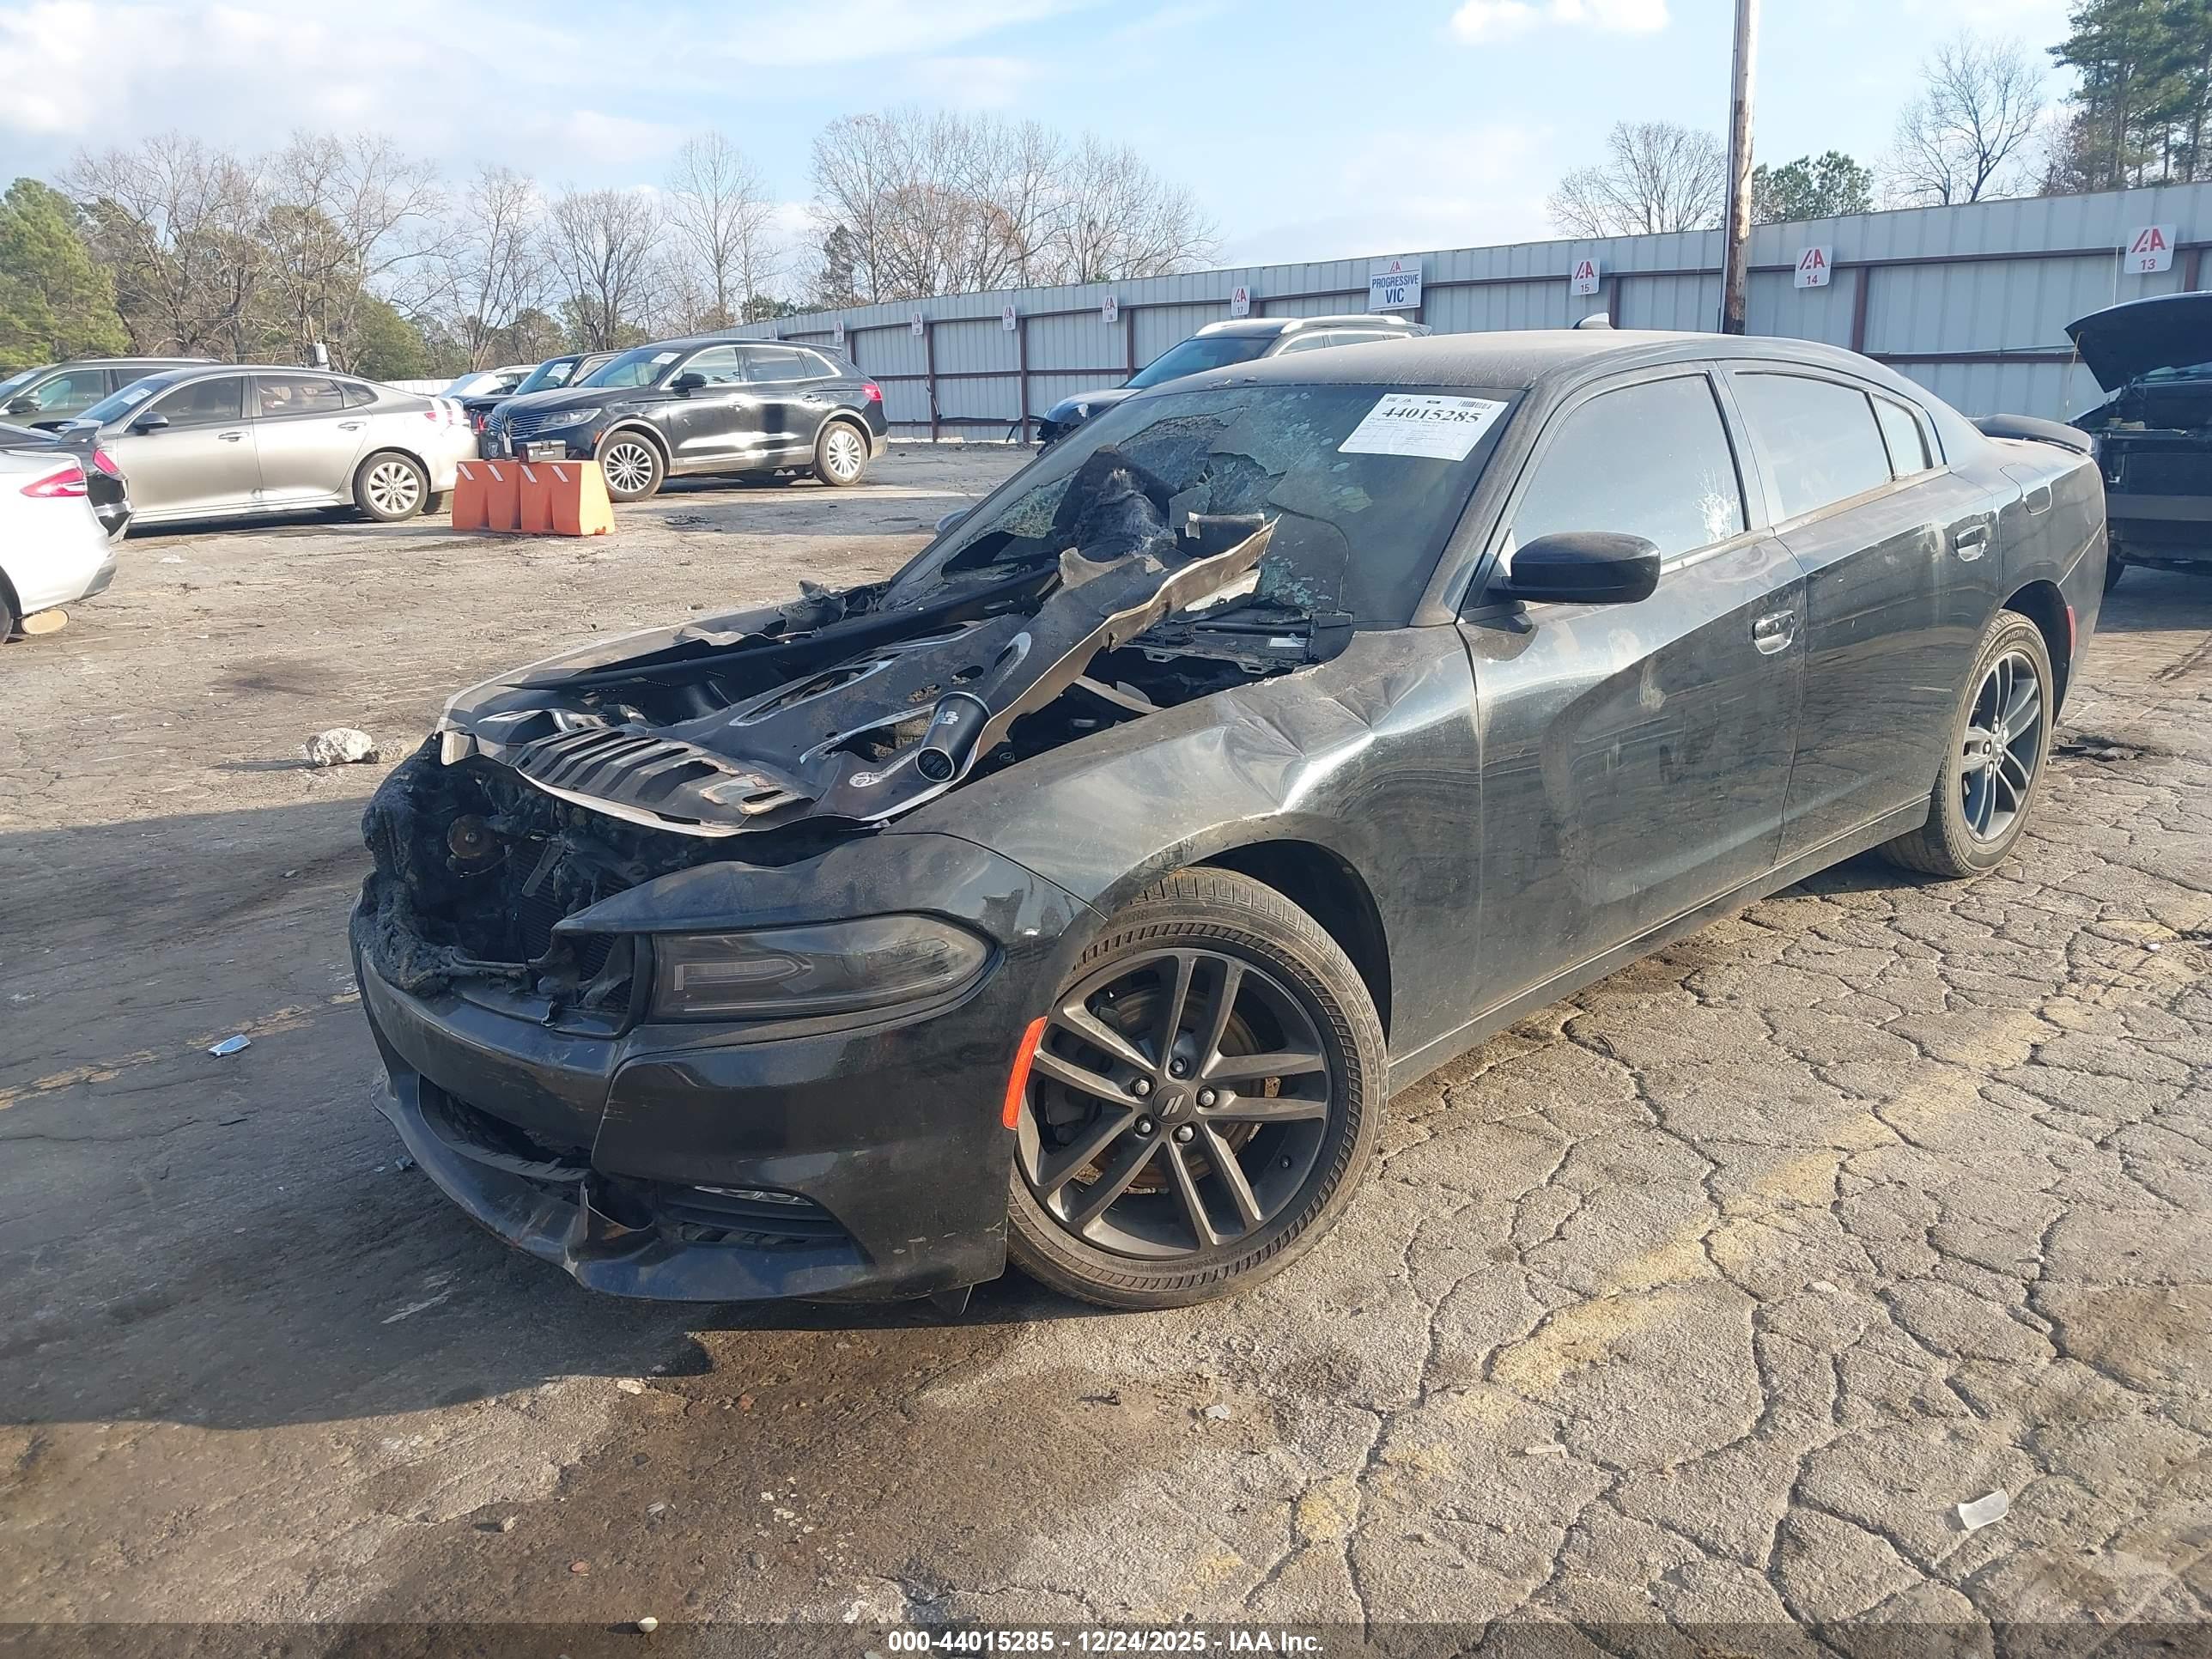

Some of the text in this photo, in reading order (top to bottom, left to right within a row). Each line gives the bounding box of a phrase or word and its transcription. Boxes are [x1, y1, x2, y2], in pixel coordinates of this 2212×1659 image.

[2140, 258, 2156, 270] 13
[1371, 274, 1419, 289] PROGRESSIVE
[1806, 274, 1819, 285] 14
[1580, 283, 1590, 293] 15
[1385, 288, 1405, 304] VIC
[1237, 306, 1244, 314] 17
[1382, 406, 1483, 423] 44015285
[1980, 629, 2027, 674] SCORPION
